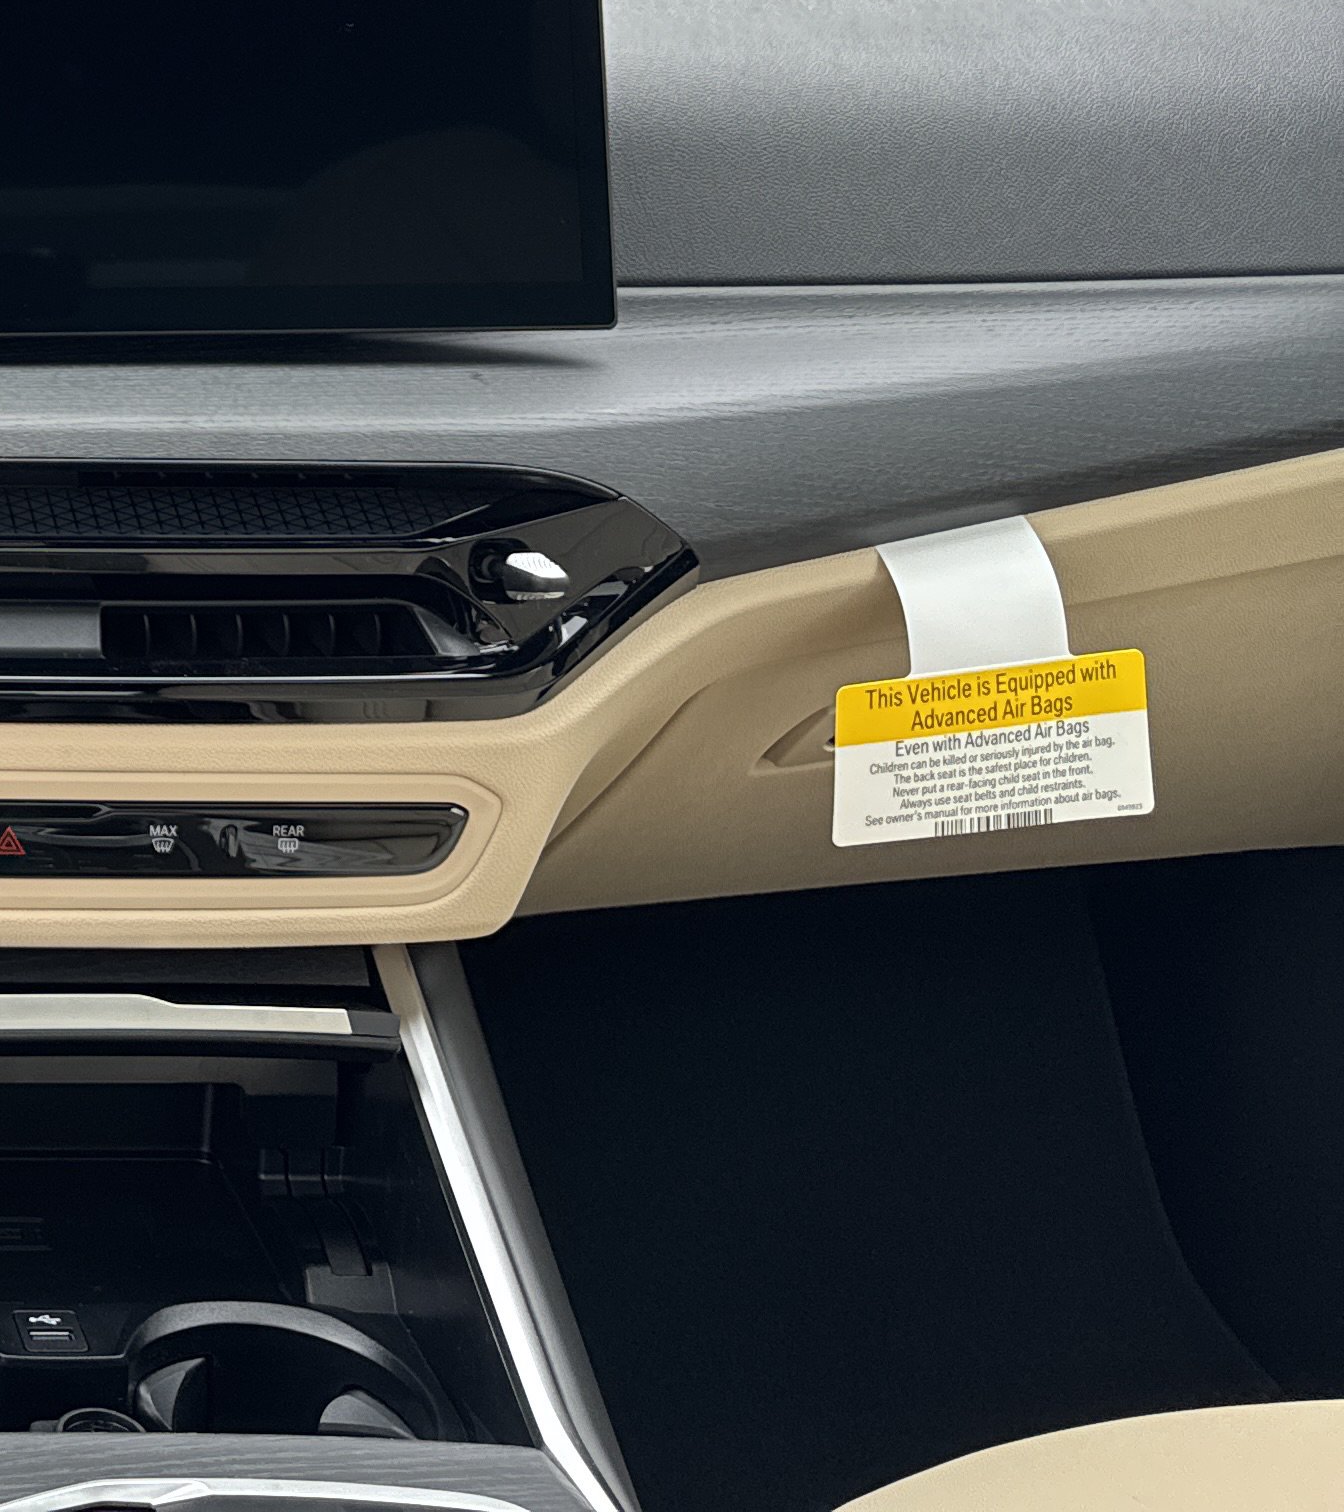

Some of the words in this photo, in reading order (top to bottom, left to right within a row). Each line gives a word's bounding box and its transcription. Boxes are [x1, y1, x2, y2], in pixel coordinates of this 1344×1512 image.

[865, 686, 903, 710] This
[907, 678, 972, 705] Vehicle
[976, 676, 991, 696] is
[996, 664, 1076, 696] Equipped
[1080, 659, 1117, 682] with
[911, 700, 998, 731] Advanced
[1002, 697, 1027, 720] Air
[1031, 695, 1073, 717] Bags
[869, 760, 909, 775] Children
[911, 760, 927, 772] can
[929, 756, 941, 768] be
[943, 753, 967, 766] killed
[968, 753, 978, 763] or
[980, 746, 1020, 762] seriously
[1021, 741, 1051, 758] injured
[1053, 741, 1064, 755] by
[1065, 739, 1080, 750] the
[1082, 738, 1092, 748] air
[1095, 736, 1116, 748] bag.
[895, 740, 929, 757] Even
[932, 733, 962, 753] with
[964, 724, 1031, 749] Advanced
[1034, 722, 1053, 740] Air
[1056, 719, 1090, 738] Bags
[892, 786, 919, 798] Never
[921, 784, 938, 798] put
[938, 783, 945, 793] a
[946, 776, 997, 792] rear-facing
[998, 773, 1020, 786] child
[1021, 770, 1041, 783] seat
[1042, 769, 1051, 780] in
[1052, 767, 1067, 779] the
[1068, 764, 1094, 776] front.
[894, 773, 912, 785] The
[913, 770, 935, 782] back
[937, 768, 957, 780] seat
[958, 766, 967, 777] is
[968, 764, 983, 776] the
[985, 760, 1013, 774] safest
[1014, 758, 1038, 772] place
[1039, 756, 1052, 767] for
[1053, 752, 1092, 765] children.
[865, 815, 884, 827] See
[885, 810, 923, 825] owner's
[924, 806, 959, 820] manual
[960, 804, 972, 815] for
[973, 802, 998, 814] more
[1000, 796, 1052, 811] information
[1053, 792, 1080, 805] about
[1081, 790, 1093, 800] air
[1095, 788, 1122, 801] bags.
[900, 798, 932, 810] Always
[934, 795, 951, 806] use
[952, 793, 972, 805] seat
[974, 790, 997, 801] belts
[998, 787, 1016, 799] and
[1017, 784, 1039, 797] child
[149, 824, 178, 837] MAX
[272, 824, 305, 837] REAR
